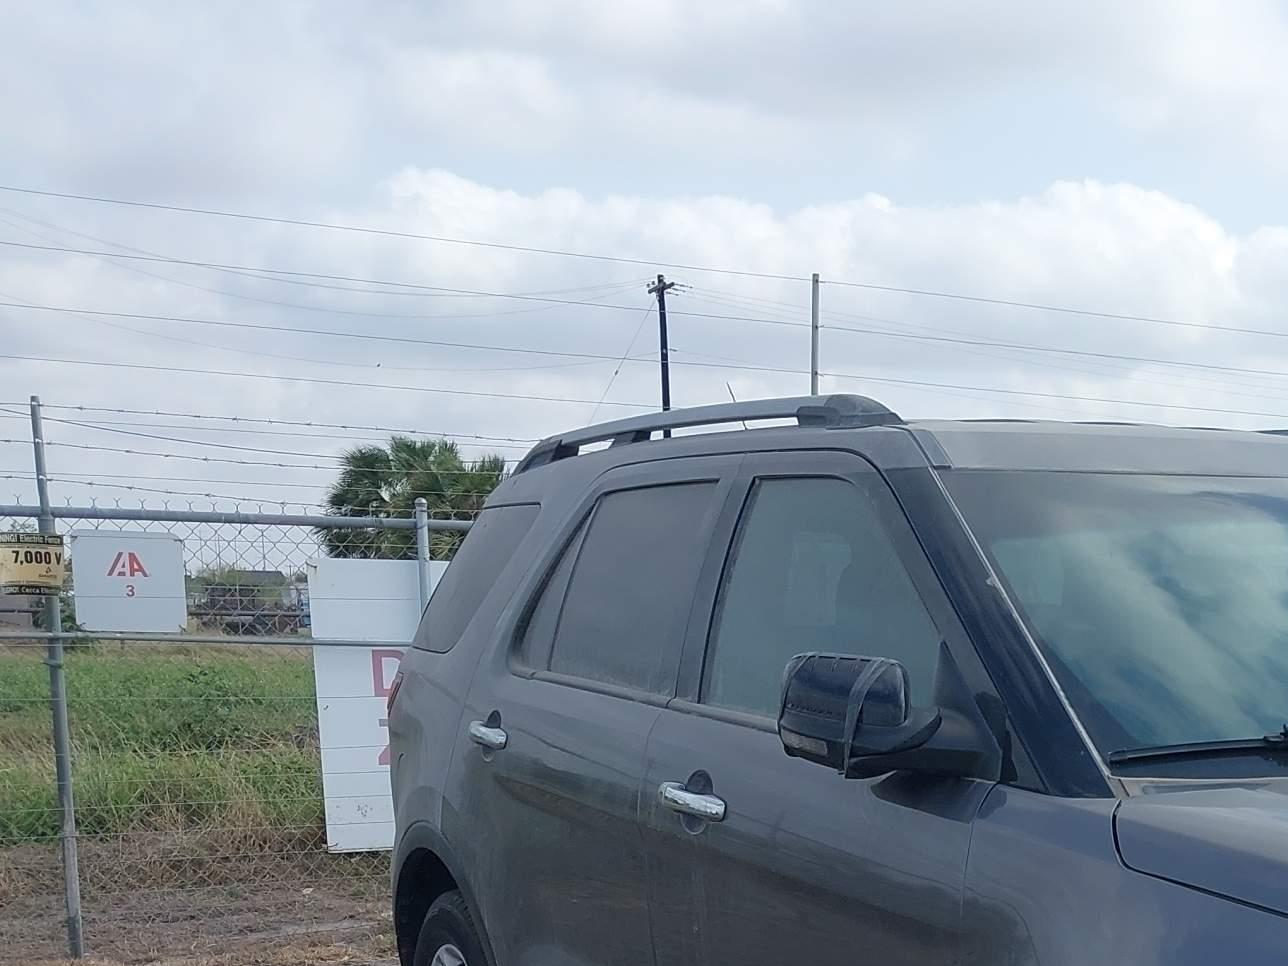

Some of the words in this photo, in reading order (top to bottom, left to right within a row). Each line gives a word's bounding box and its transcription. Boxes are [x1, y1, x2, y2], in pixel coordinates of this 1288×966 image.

[11, 550, 52, 566] 7,000
[54, 551, 62, 566] V
[125, 584, 136, 597] 3
